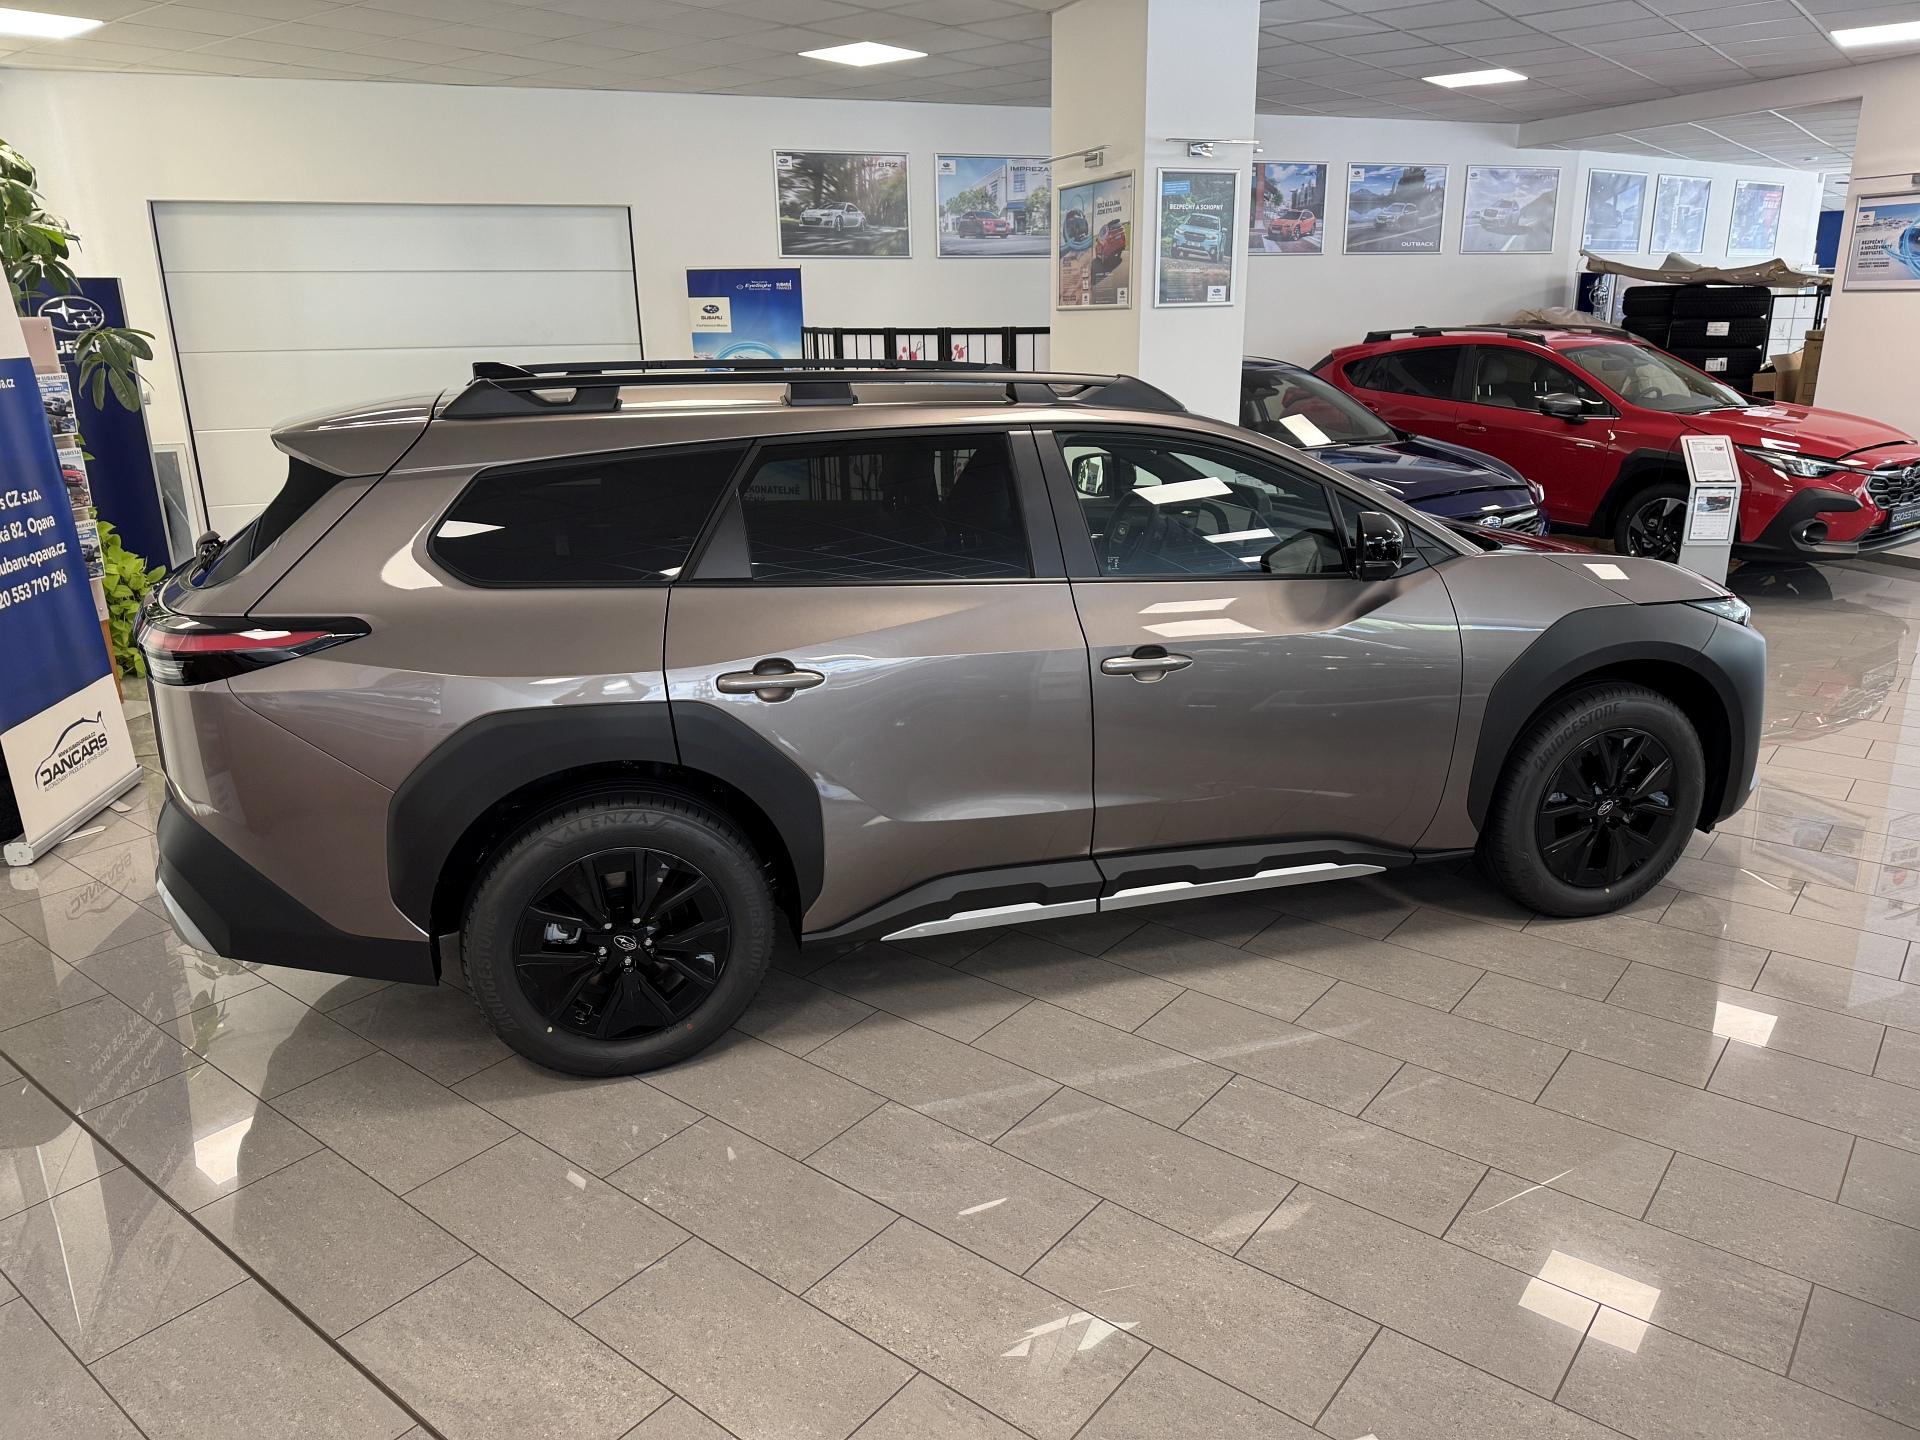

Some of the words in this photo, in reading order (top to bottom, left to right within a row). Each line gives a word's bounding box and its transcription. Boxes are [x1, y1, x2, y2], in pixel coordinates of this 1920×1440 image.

[6, 490, 21, 508] CZ
[21, 489, 42, 505] s.r.o.
[10, 521, 27, 538] 82,
[27, 515, 55, 536] Opava
[0, 542, 67, 576] ubaru-opava.cz
[11, 582, 31, 603] 553
[31, 575, 49, 595] 719
[51, 568, 67, 588] 296
[40, 732, 108, 786] DANCARS
[563, 813, 649, 838] ALENZA
